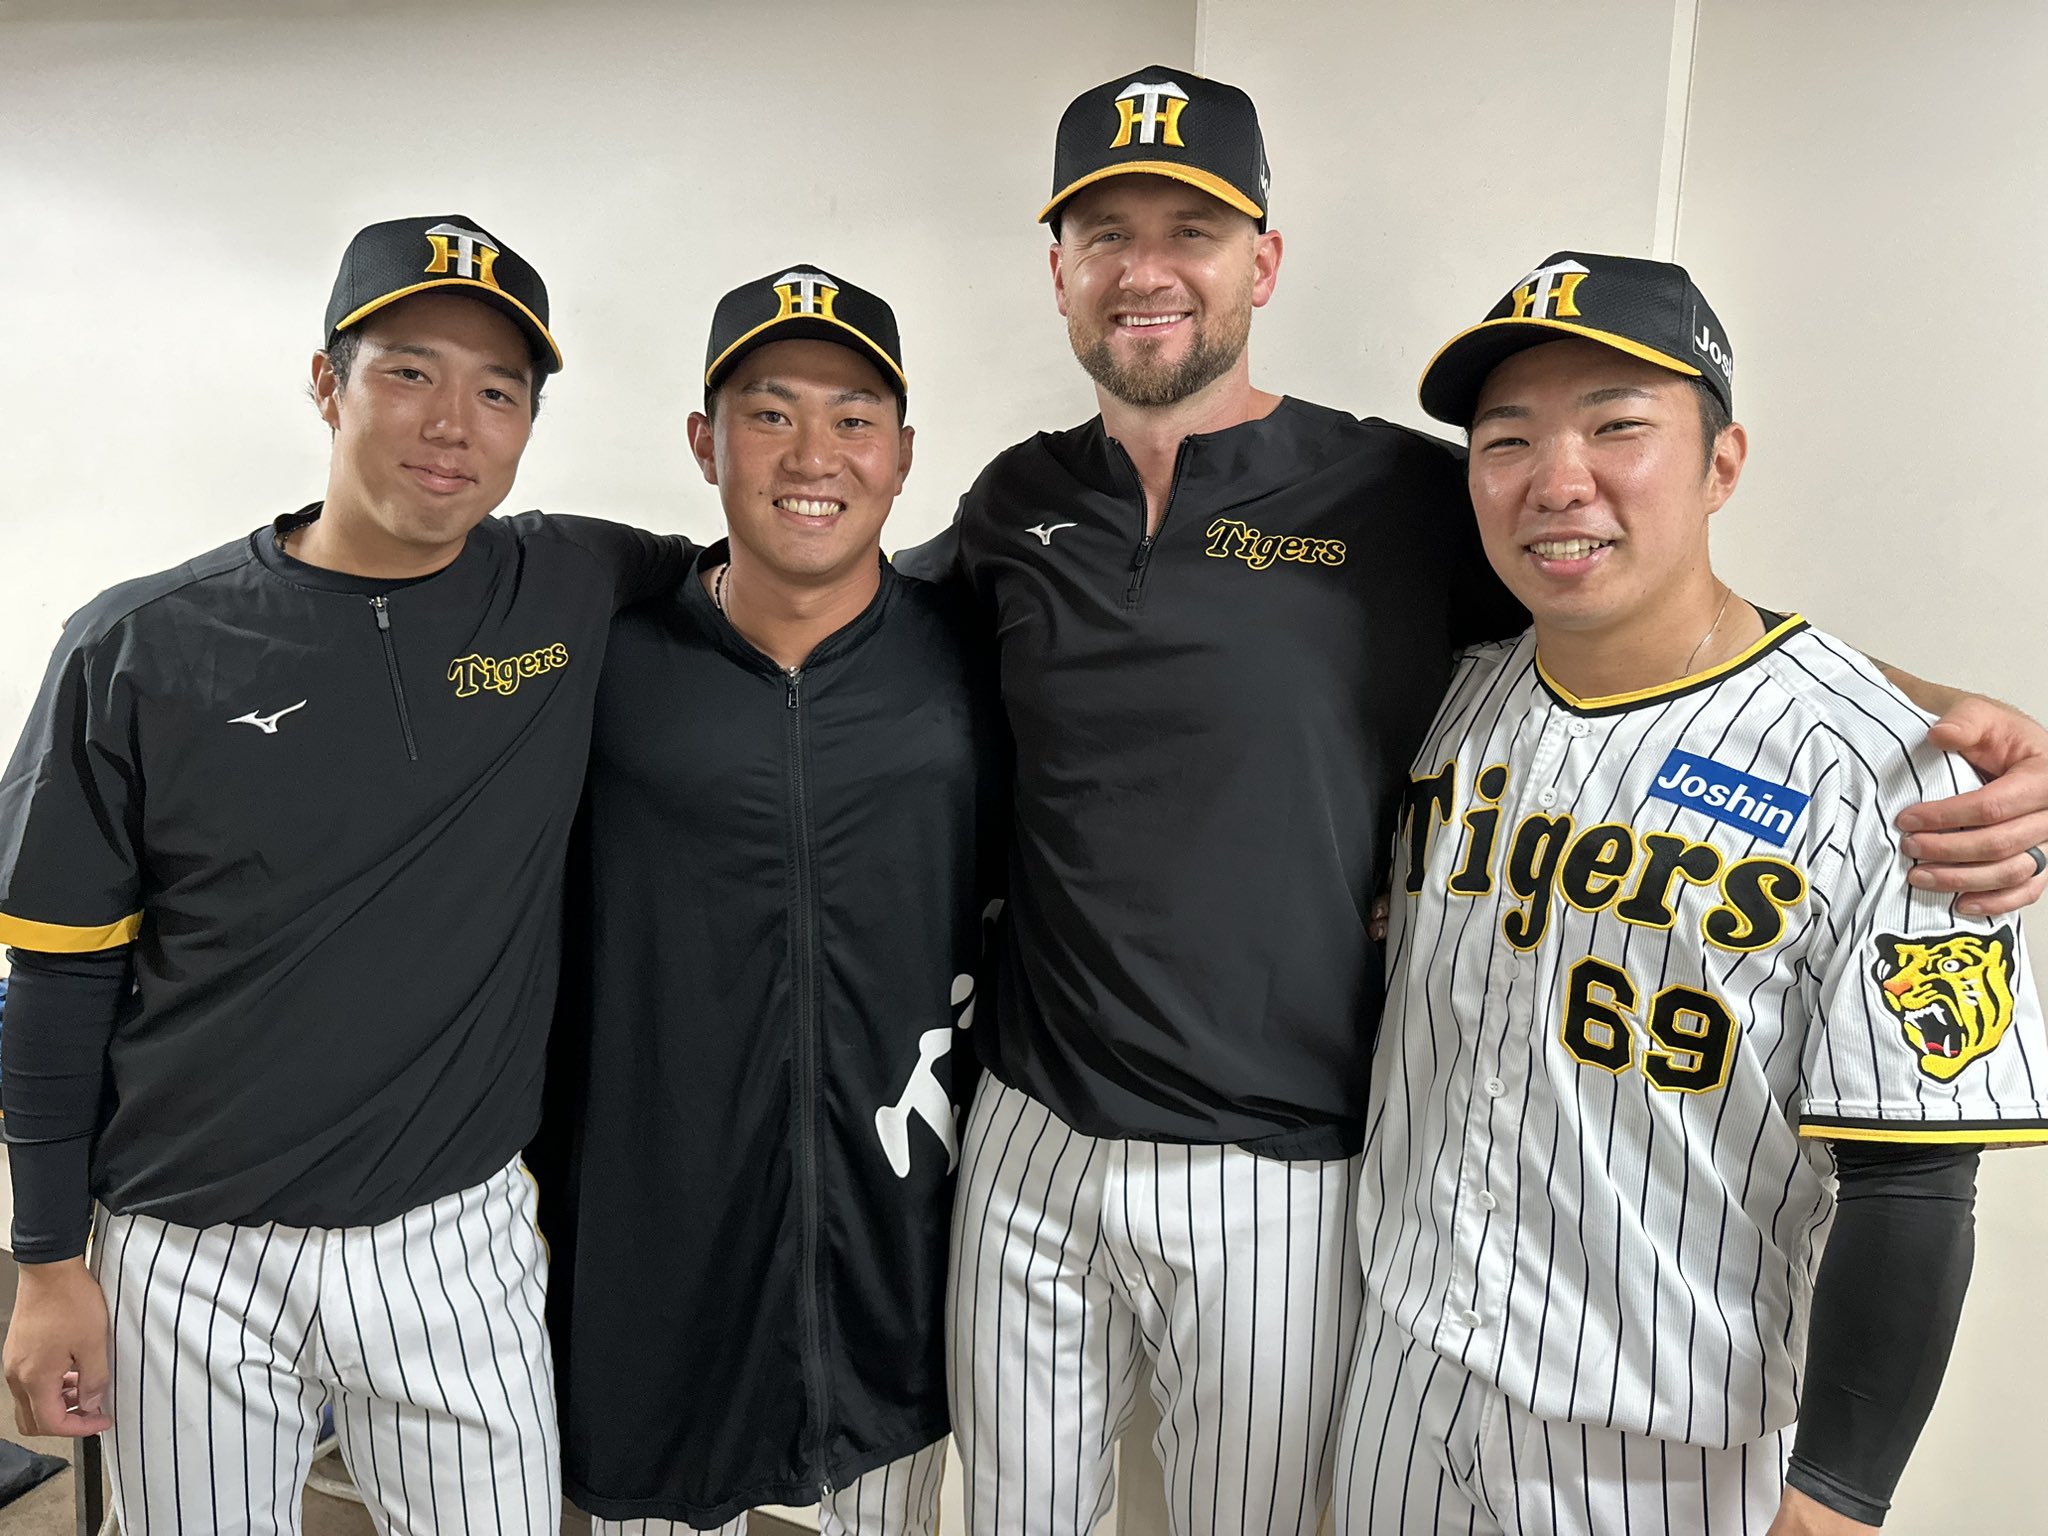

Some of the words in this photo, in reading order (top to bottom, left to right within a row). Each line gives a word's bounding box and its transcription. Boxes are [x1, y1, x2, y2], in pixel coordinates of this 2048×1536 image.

[1206, 518, 1347, 570] Tigers
[447, 642, 569, 697] Tigers
[1657, 763, 1796, 834] Joshin
[1402, 759, 1806, 952] Tigers
[1559, 955, 1737, 1094] 69
